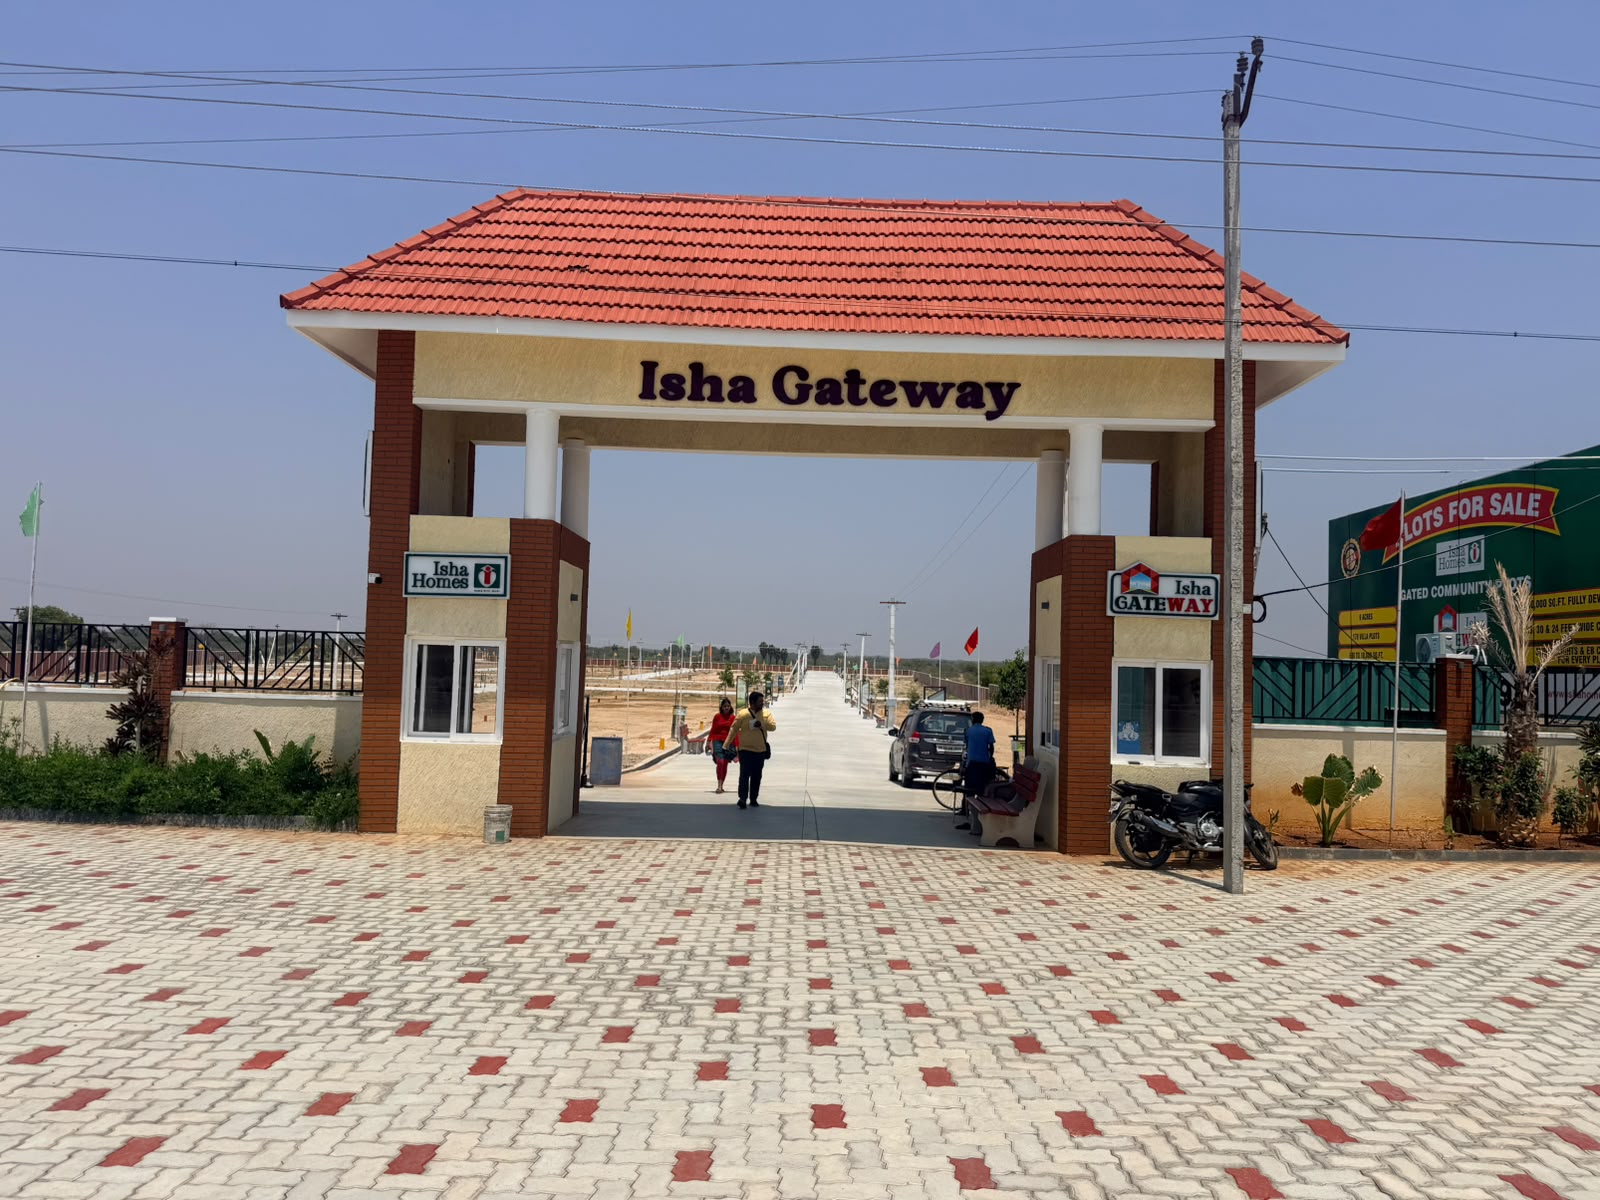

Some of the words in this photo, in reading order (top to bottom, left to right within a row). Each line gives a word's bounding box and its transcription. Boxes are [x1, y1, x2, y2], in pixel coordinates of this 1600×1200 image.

[638, 360, 757, 404] Isha
[771, 364, 1022, 421] Gateway
[1403, 505, 1444, 542] LOTS
[1448, 495, 1484, 523] FOR
[1490, 492, 1541, 517] SALE
[433, 561, 469, 577] Isha
[1438, 557, 1466, 571] Homes
[411, 573, 469, 589] Homes
[1175, 580, 1211, 595] Isha
[1401, 587, 1428, 601] GATED
[1497, 575, 1532, 593] POTS
[1114, 595, 1214, 613] GATEWAY
[1529, 599, 1547, 609] 0,000
[1568, 595, 1587, 605] FULLY
[1571, 655, 1590, 664] EVERY
